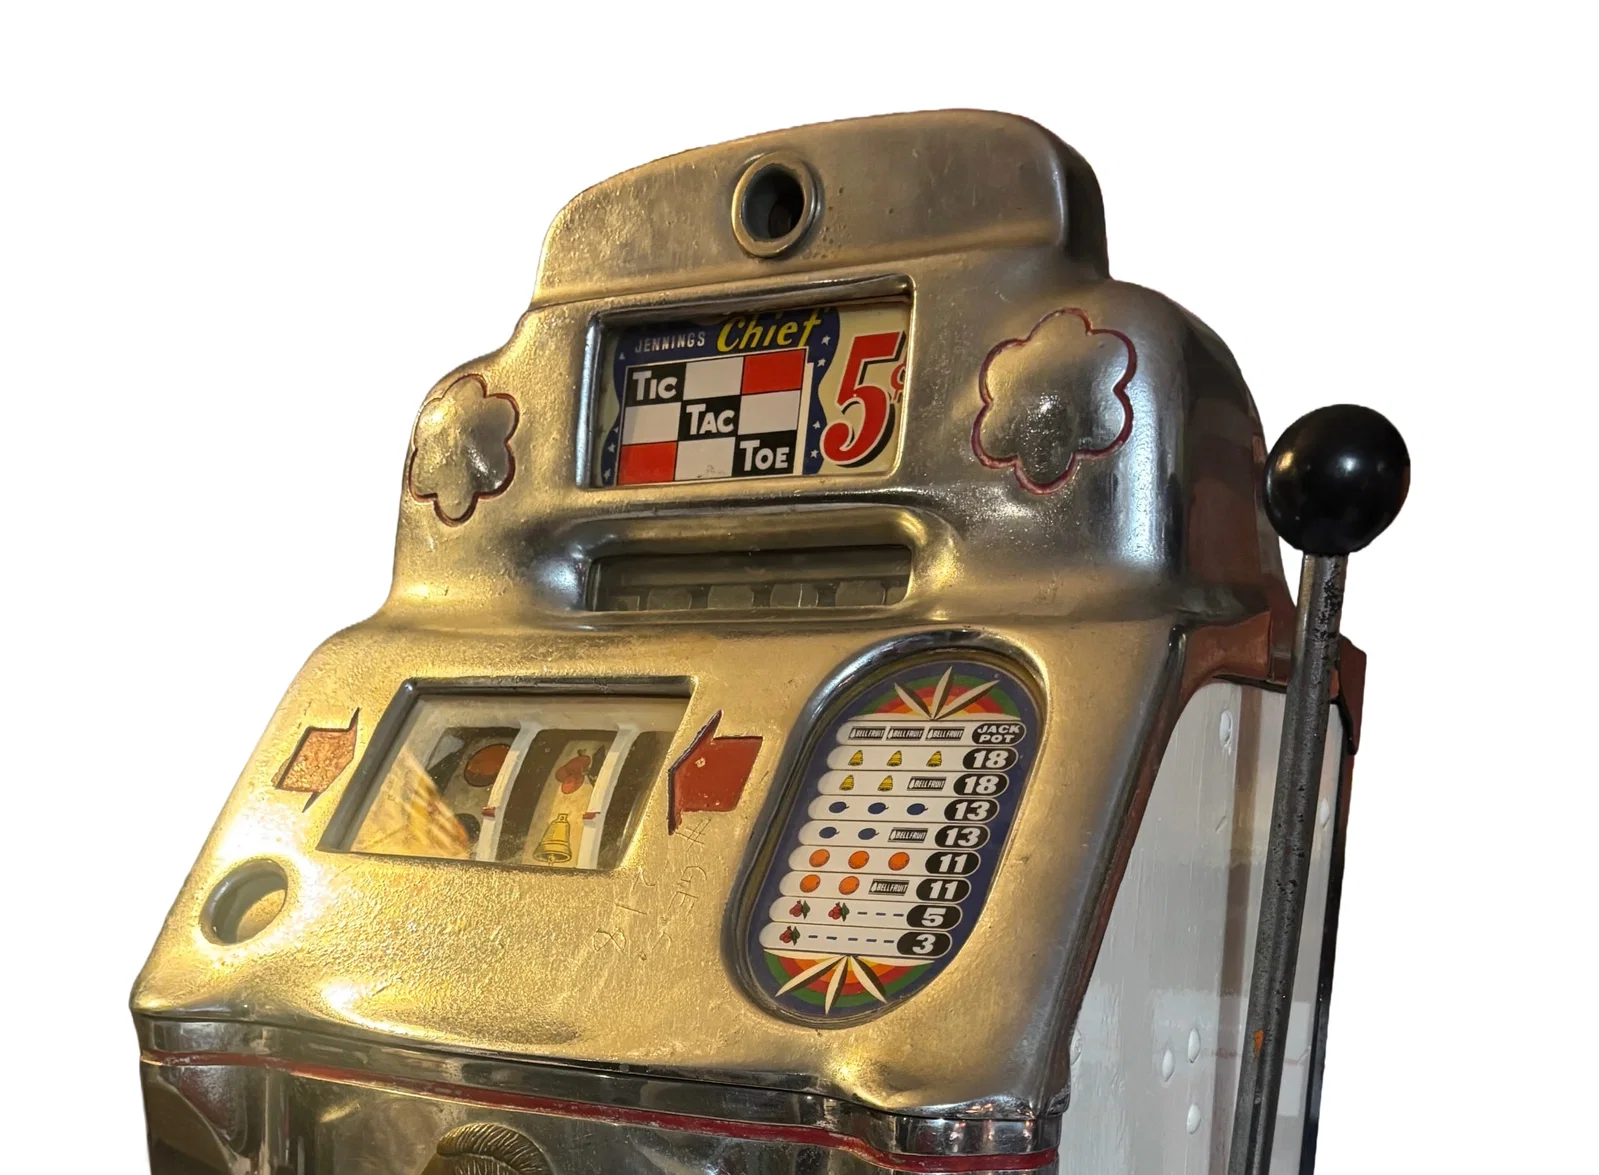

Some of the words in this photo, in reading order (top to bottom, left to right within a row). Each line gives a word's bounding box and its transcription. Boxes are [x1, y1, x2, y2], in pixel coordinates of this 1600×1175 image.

[634, 332, 705, 353] JENNINGS
[716, 311, 822, 352] Chief
[977, 724, 1020, 734] JACK
[978, 734, 1014, 743] POT
[973, 750, 1009, 769] 18
[963, 775, 999, 794] 18
[953, 801, 991, 820] 13
[945, 827, 981, 846] 13
[939, 854, 968, 873] 11
[929, 881, 959, 899] 11
[921, 907, 948, 926] 5
[912, 934, 935, 954] 3
